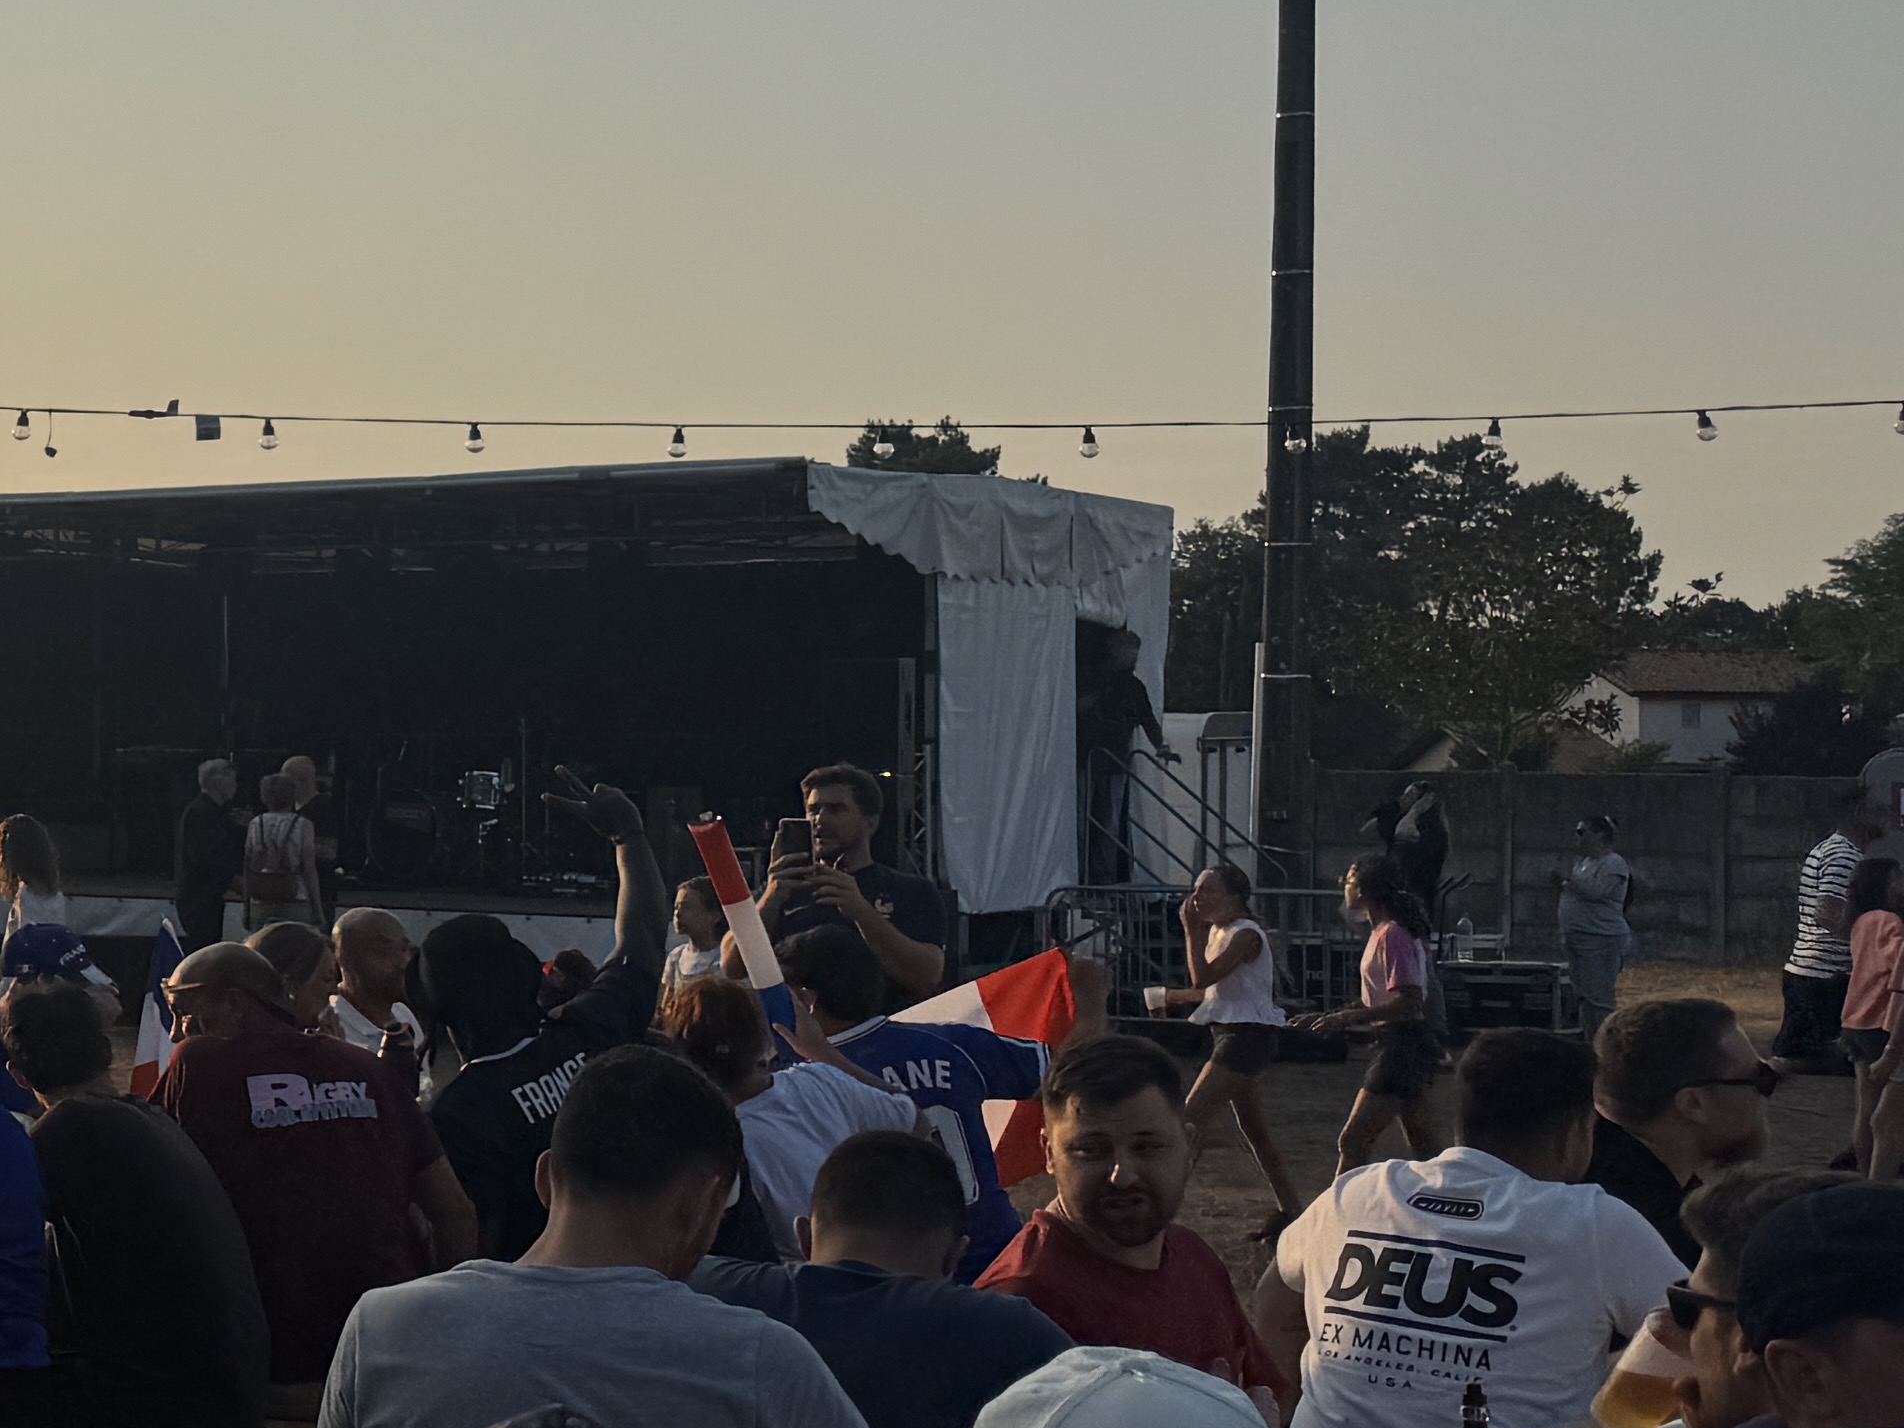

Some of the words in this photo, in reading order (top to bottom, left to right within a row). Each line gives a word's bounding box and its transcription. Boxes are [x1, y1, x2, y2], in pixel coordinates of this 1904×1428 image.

[882, 1058, 952, 1092] ANE
[1324, 1242, 1523, 1329] DEUS
[1320, 1322, 1344, 1345] EX
[1352, 1327, 1492, 1372] MACHINA
[1367, 1374, 1413, 1389] USA
